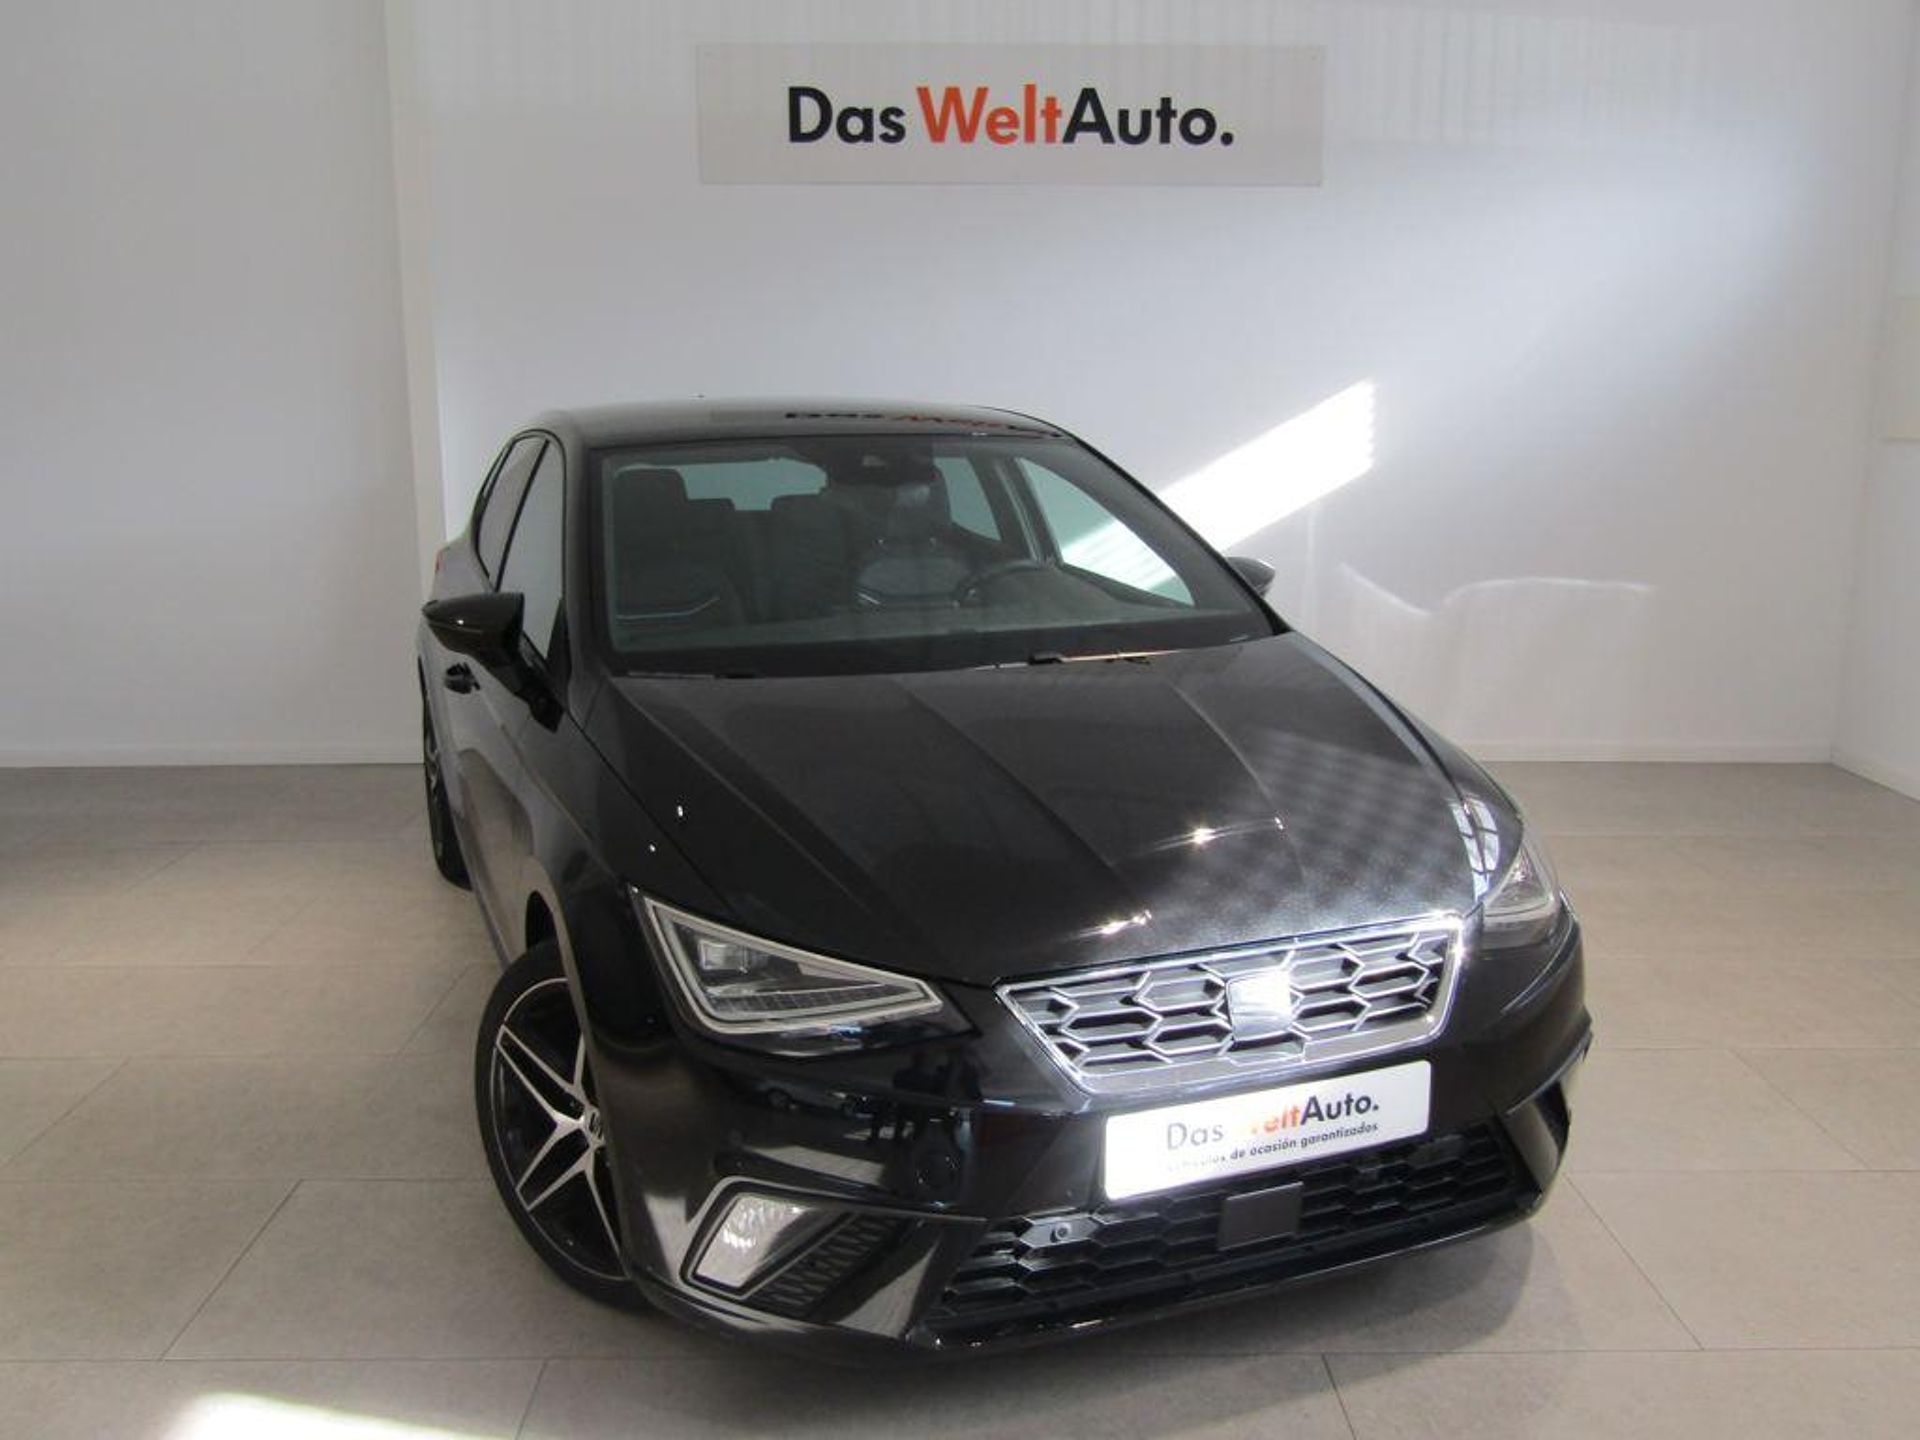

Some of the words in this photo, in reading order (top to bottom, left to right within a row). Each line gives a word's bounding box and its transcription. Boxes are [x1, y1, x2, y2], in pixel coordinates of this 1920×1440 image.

[788, 86, 906, 143] Das
[916, 83, 1234, 145] WeltAuto.
[1167, 1122, 1225, 1150] Das
[1236, 1092, 1379, 1134] eltAuto.
[1230, 1147, 1248, 1161] de
[1250, 1137, 1297, 1157] ocasión
[1300, 1121, 1379, 1149] garantizados
